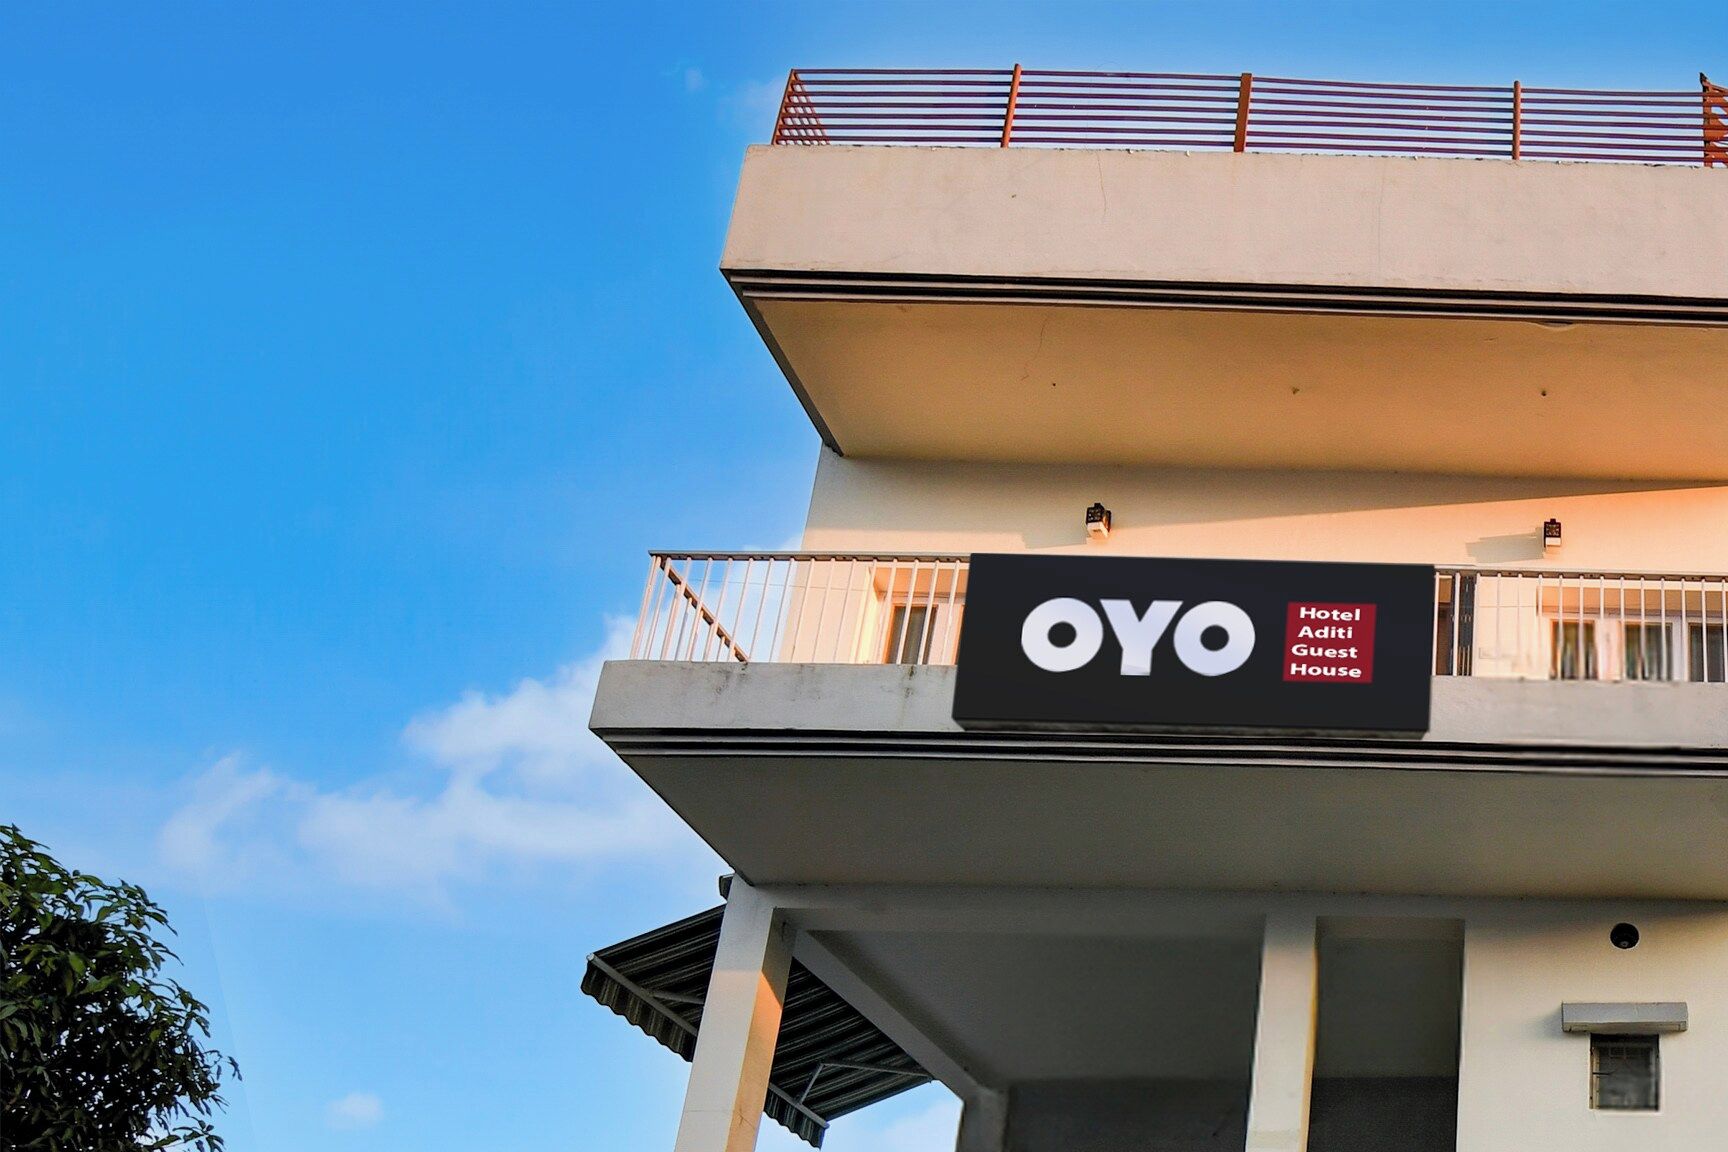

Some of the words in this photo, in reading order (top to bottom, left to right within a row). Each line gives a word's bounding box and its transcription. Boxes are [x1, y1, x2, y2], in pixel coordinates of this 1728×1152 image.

[1300, 606, 1361, 621] Hotel
[1021, 598, 1255, 676] OYO
[1298, 626, 1353, 639] Aditi
[1291, 644, 1358, 659] Guest
[1290, 663, 1362, 678] House
